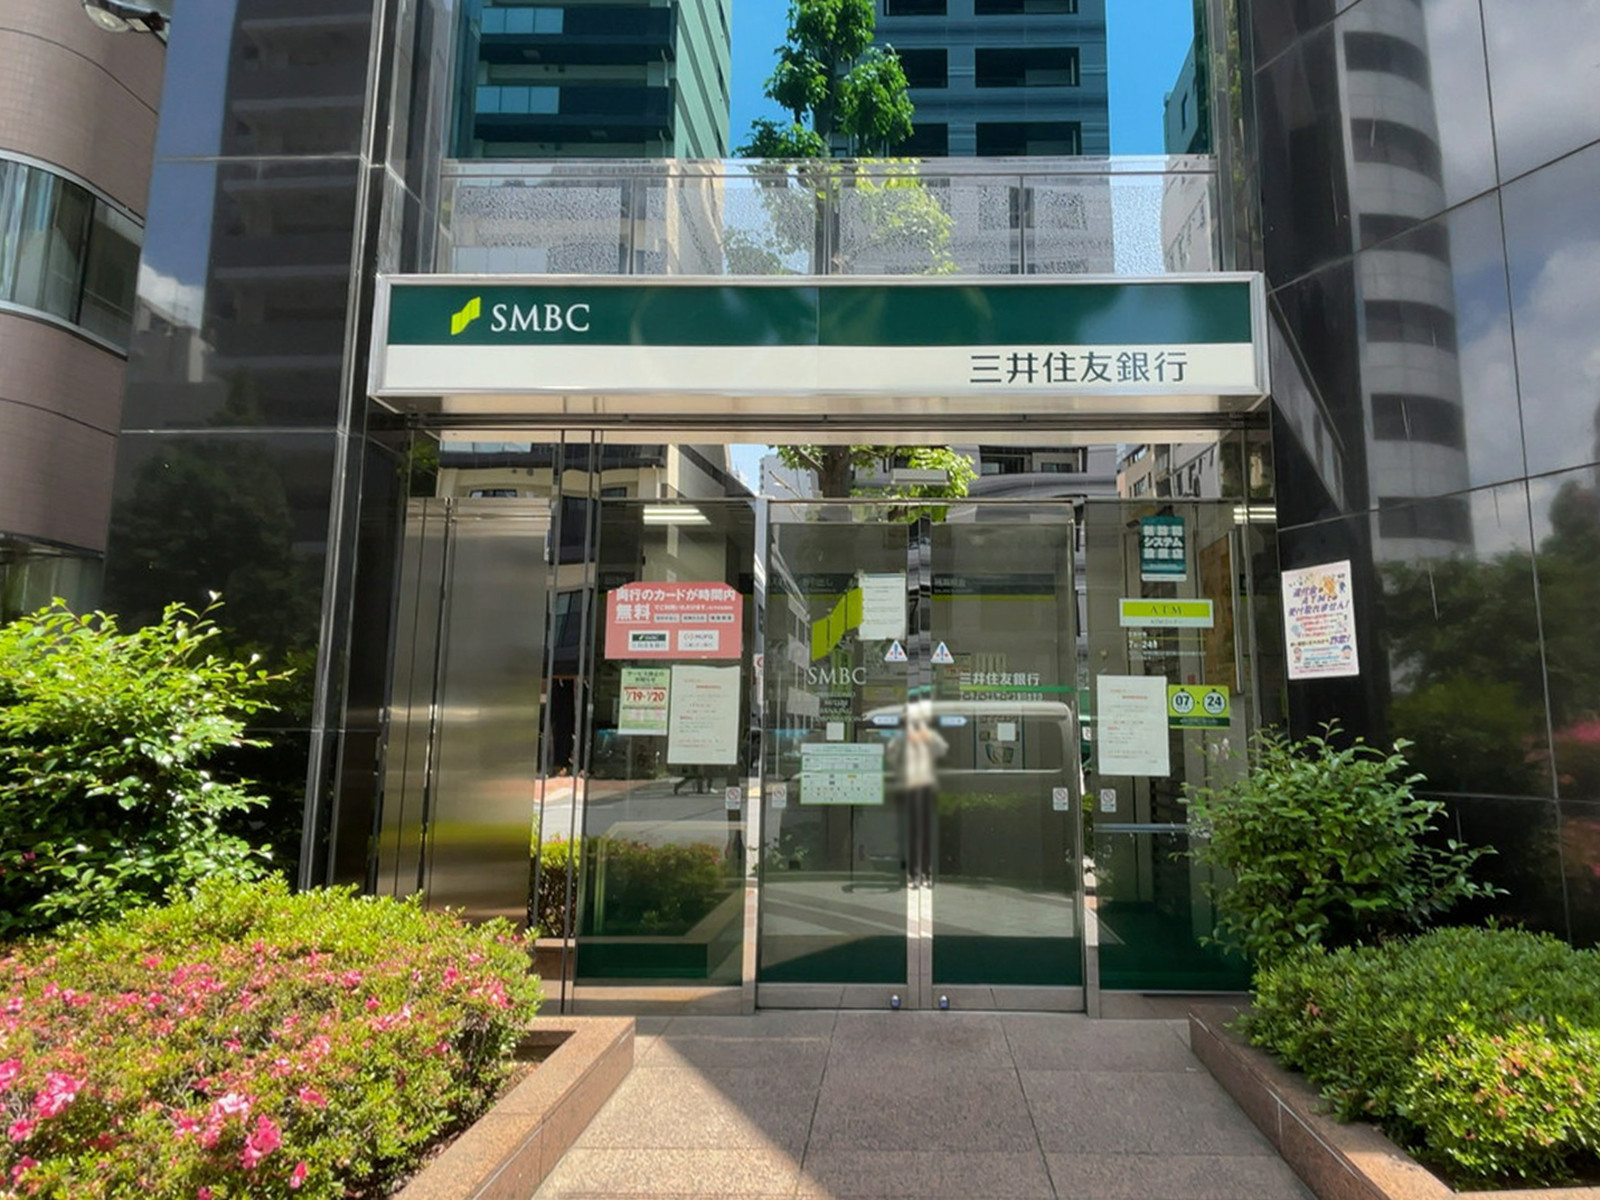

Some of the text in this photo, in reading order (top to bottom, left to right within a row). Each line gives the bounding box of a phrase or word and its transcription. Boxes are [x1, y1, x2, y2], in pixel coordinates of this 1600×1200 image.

[490, 303, 590, 333] SMBC
[969, 350, 1188, 384] 三井住友銀行
[1143, 536, 1184, 547] システム
[616, 588, 736, 602] 両行のカードが時間内
[616, 603, 651, 621] 無料
[1150, 605, 1182, 614] ATM
[807, 666, 867, 686] SMBC
[959, 672, 1040, 686] 三井住友銀行
[1175, 695, 1222, 707] 07 24
